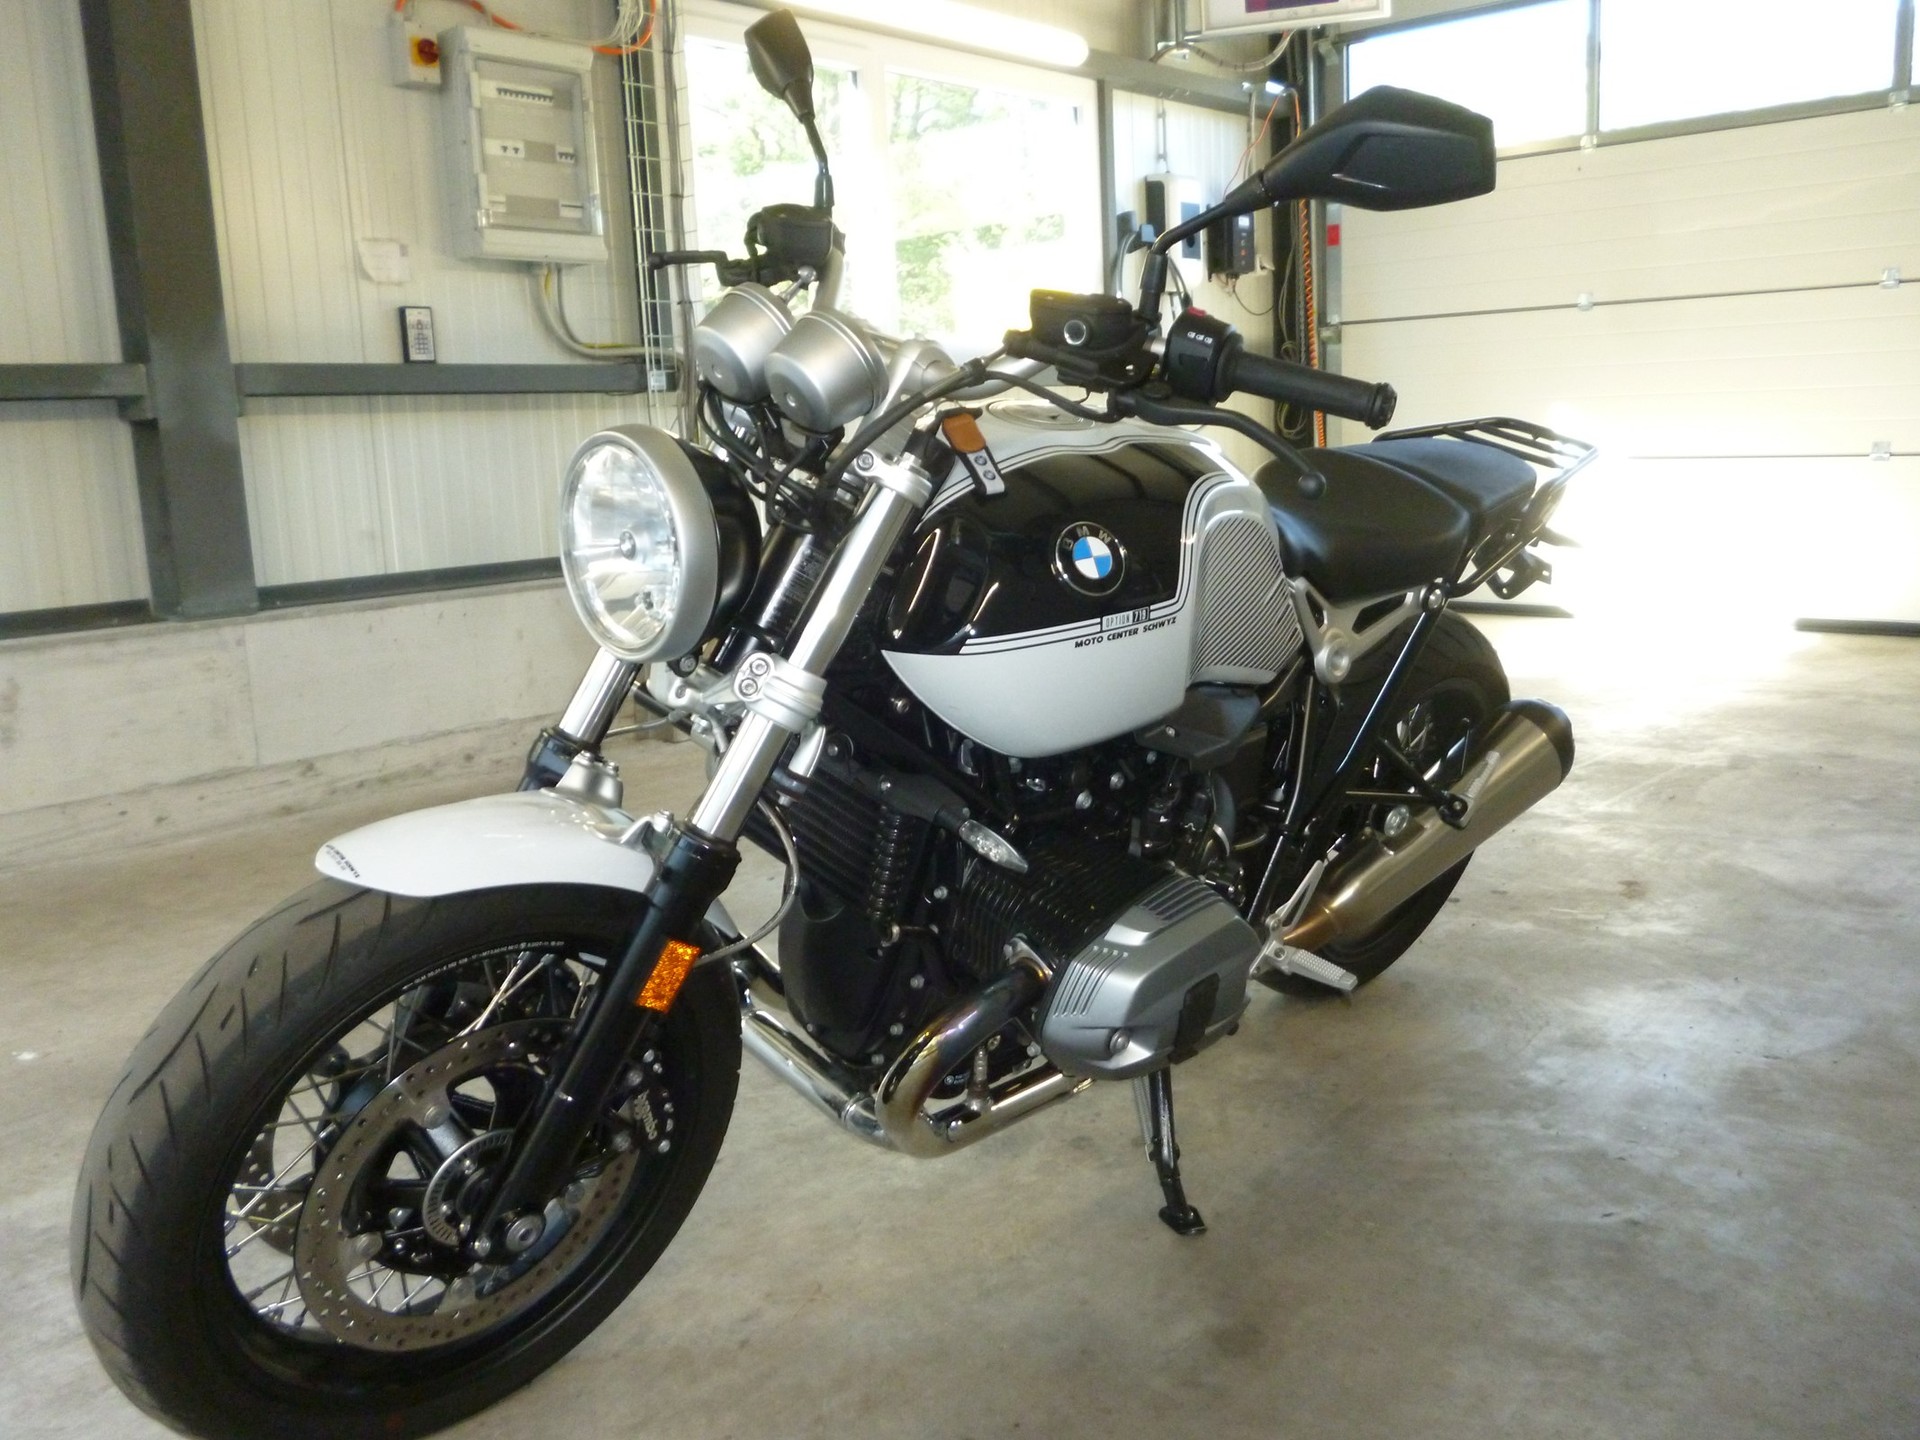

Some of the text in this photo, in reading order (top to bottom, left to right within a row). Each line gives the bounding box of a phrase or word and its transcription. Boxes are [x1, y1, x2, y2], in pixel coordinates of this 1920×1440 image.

[1062, 525, 1112, 551] BMW
[1074, 616, 1177, 648] MOTO CENTER SCHWYZ
[1105, 613, 1130, 628] OPTION
